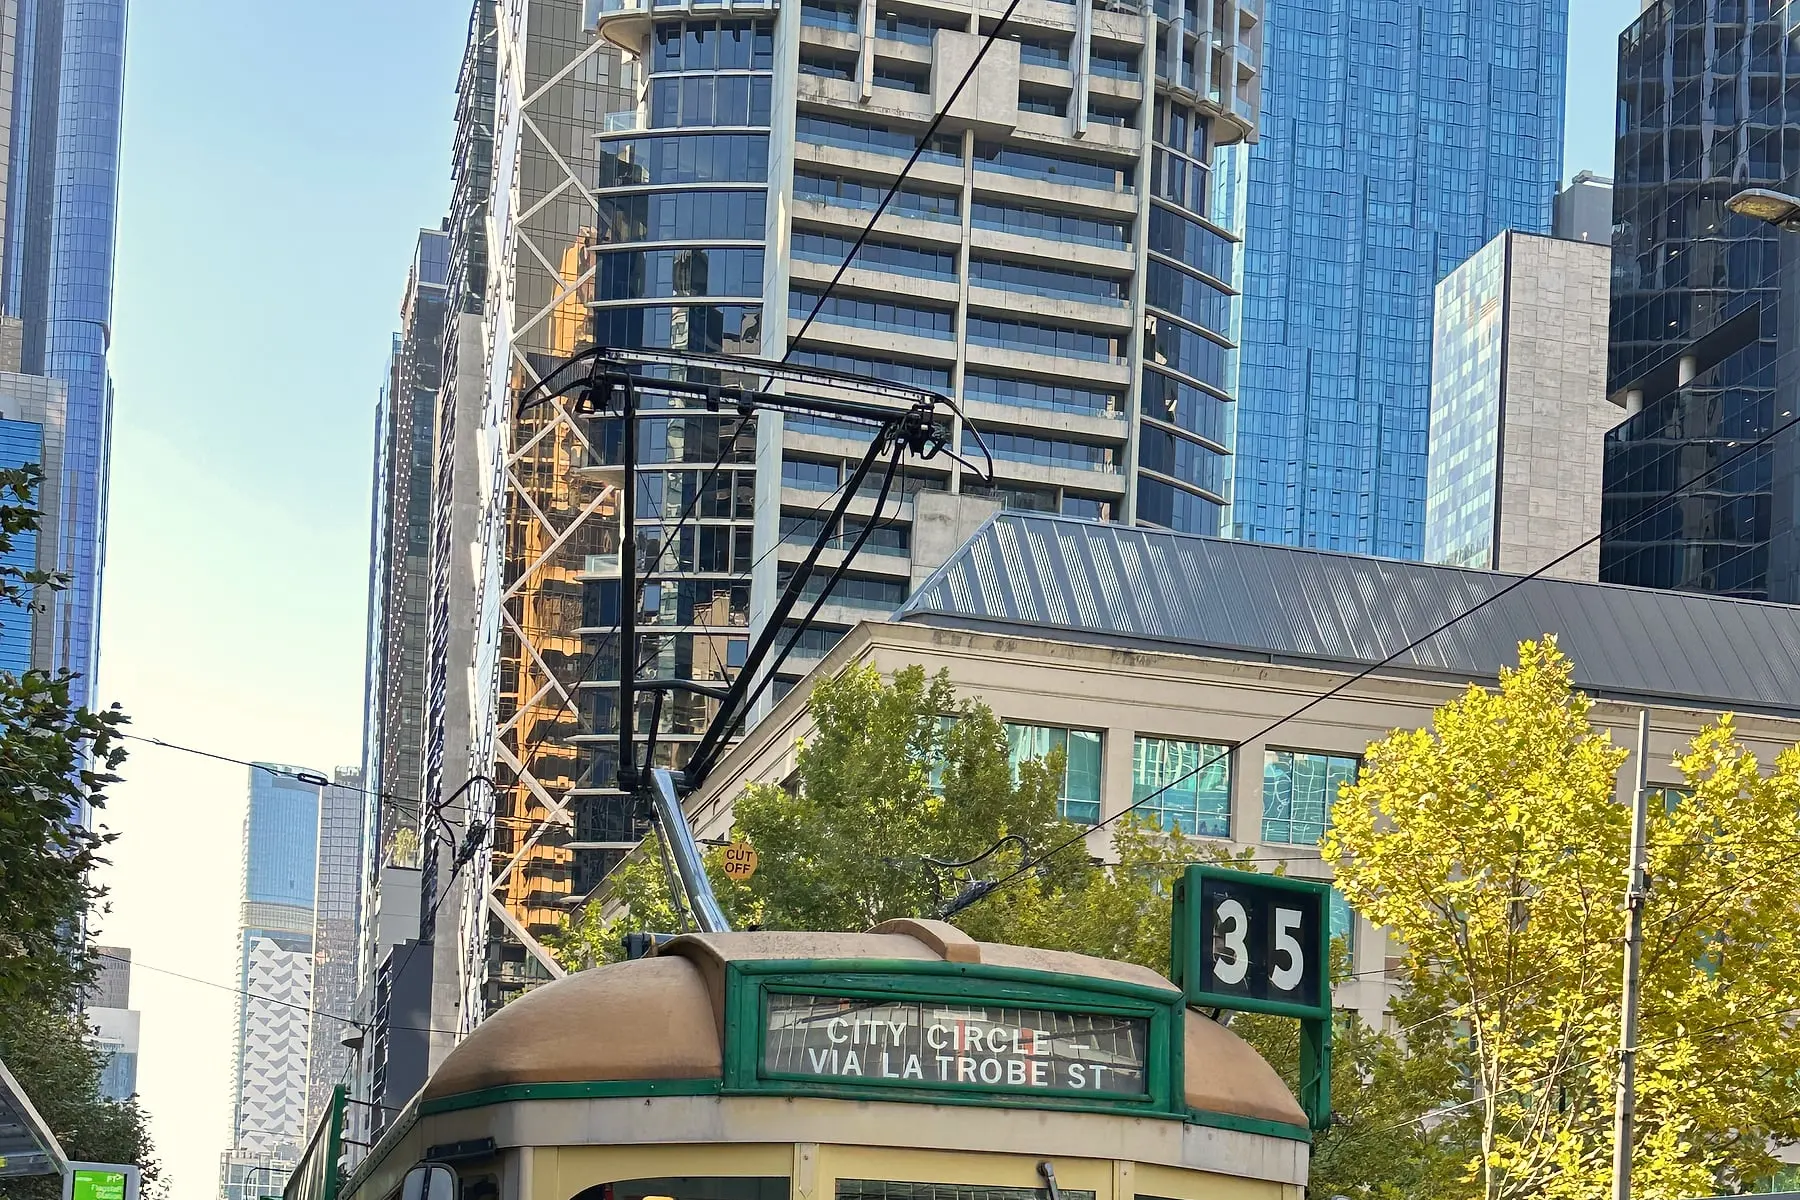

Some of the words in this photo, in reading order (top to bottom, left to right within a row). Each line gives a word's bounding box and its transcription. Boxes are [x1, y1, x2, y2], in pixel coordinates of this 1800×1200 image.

[725, 862, 751, 874] OFF
[726, 849, 753, 862] CUT
[1213, 899, 1304, 991] 35
[827, 1017, 907, 1047] CITY
[926, 1024, 1050, 1056] CIRCLE
[808, 1048, 863, 1076] VIA
[882, 1052, 923, 1080] LA
[935, 1055, 1049, 1086] TROBE
[1067, 1063, 1108, 1090] ST
